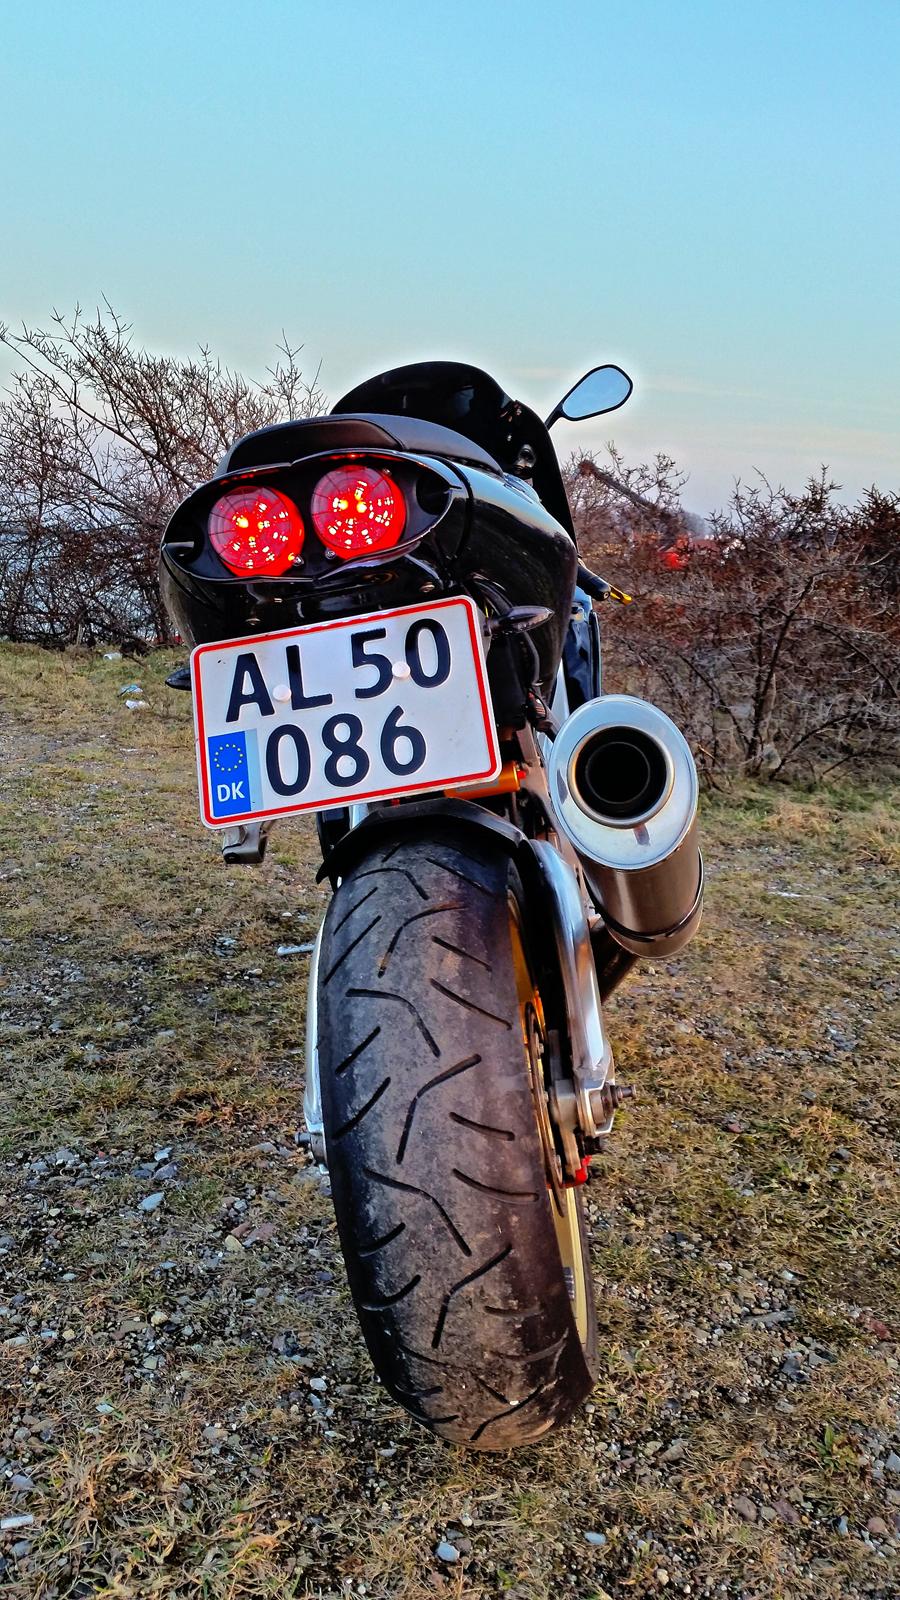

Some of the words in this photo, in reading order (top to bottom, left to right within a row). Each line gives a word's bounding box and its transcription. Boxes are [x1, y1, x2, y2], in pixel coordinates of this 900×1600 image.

[226, 644, 333, 723] AL
[350, 618, 451, 699] 50
[217, 781, 245, 802] DK
[265, 705, 427, 796] 086
